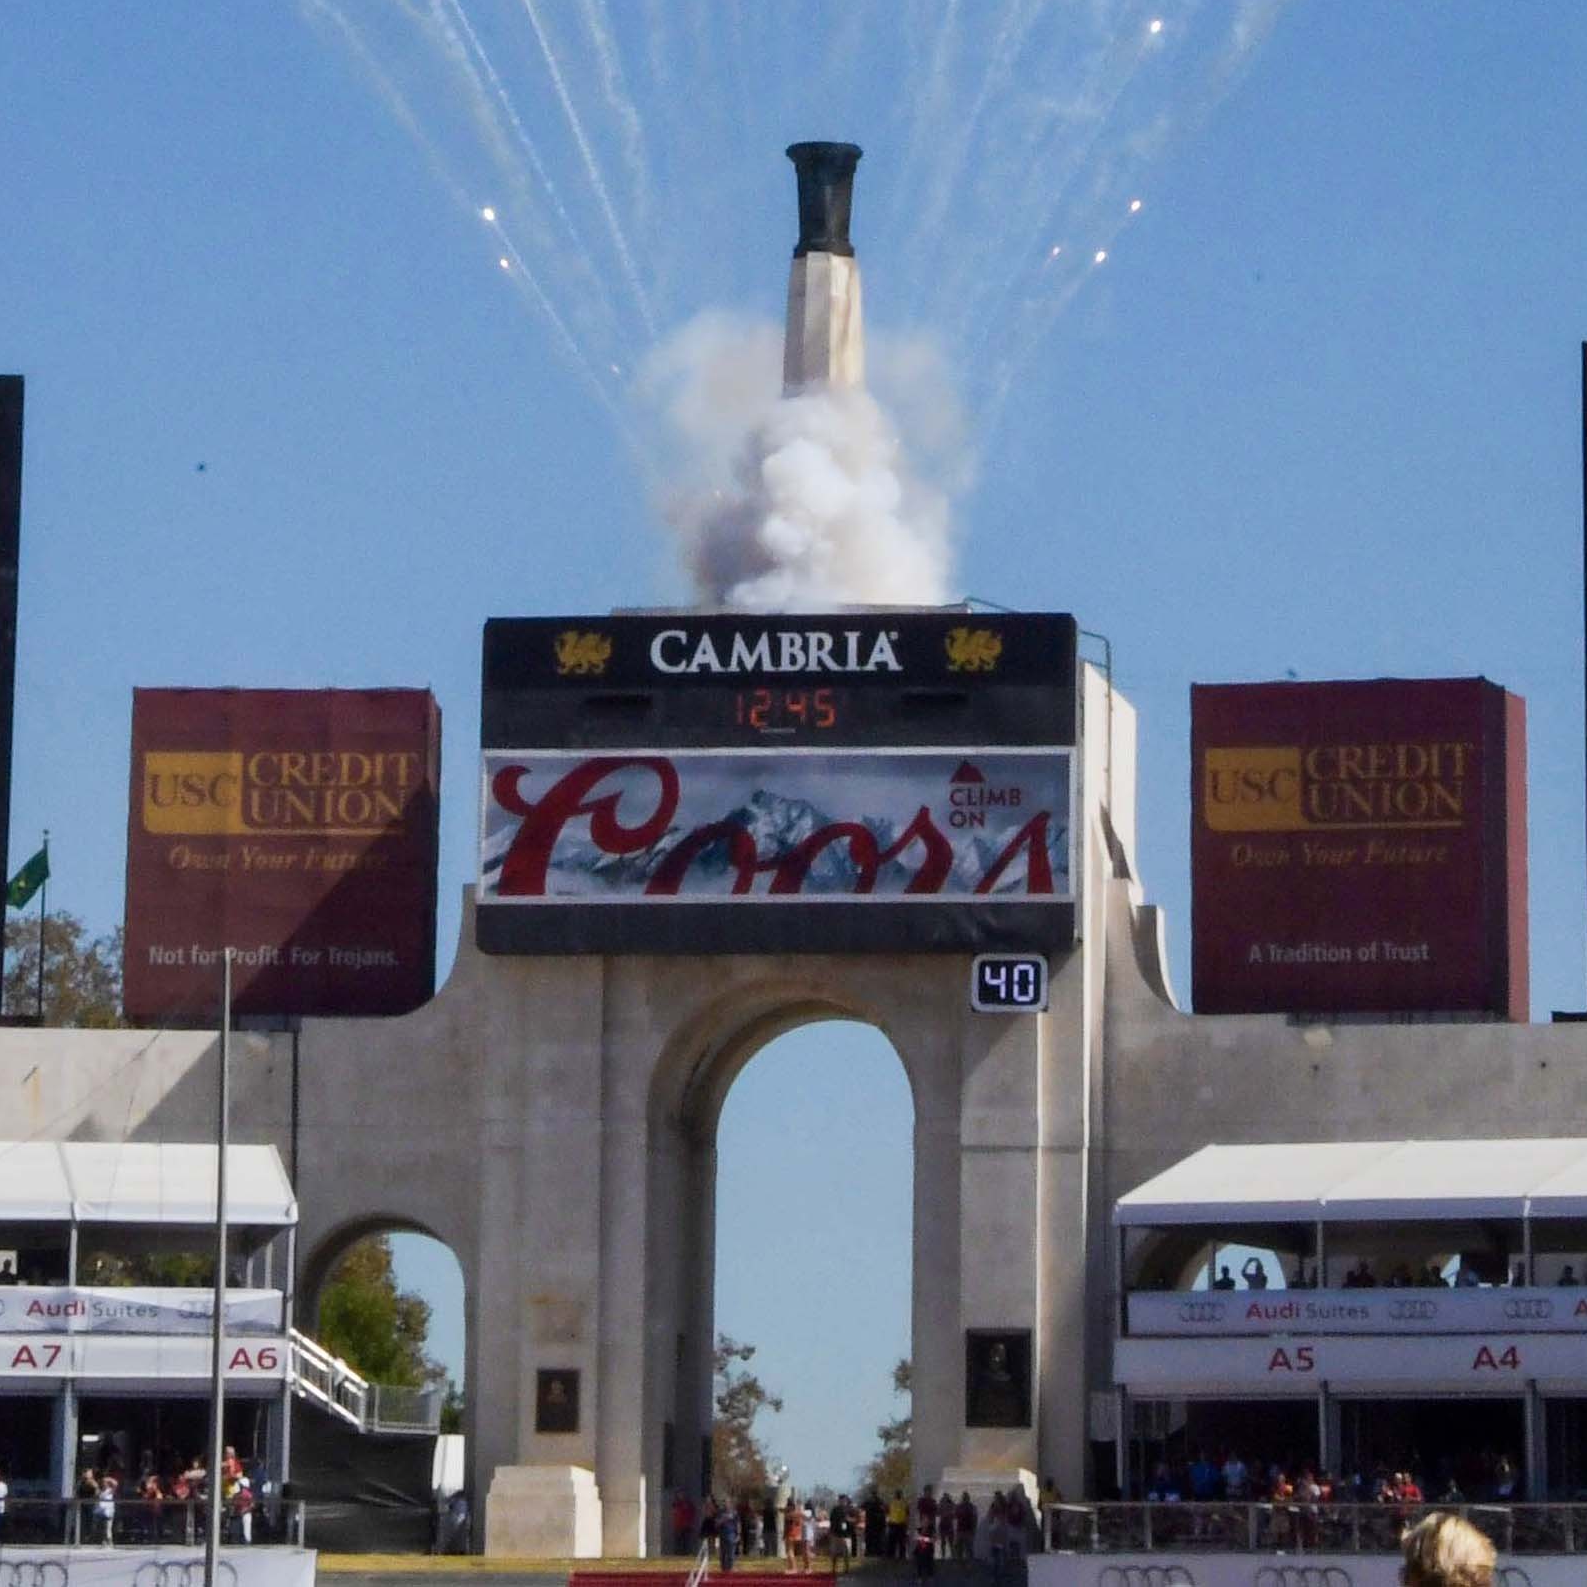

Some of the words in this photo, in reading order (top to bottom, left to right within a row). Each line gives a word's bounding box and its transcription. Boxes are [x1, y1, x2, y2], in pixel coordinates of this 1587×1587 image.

[246, 751, 419, 787] CREDIT
[1306, 743, 1472, 781] CREDIT
[148, 772, 240, 809] USC
[949, 787, 1021, 807] CLIMB
[1210, 768, 1297, 805] USC
[249, 788, 407, 825] UNION
[1308, 780, 1464, 820] UNION
[492, 755, 1055, 895] Coors
[949, 809, 985, 830] ON
[241, 845, 299, 870] Your
[148, 944, 185, 965] Not
[191, 943, 223, 965] for
[291, 946, 326, 965] For
[1248, 944, 1264, 964] A
[1268, 942, 1351, 964] Tradition
[1357, 941, 1377, 963] of
[1381, 941, 1430, 962] Trust
[984, 962, 1034, 1002] 40
[25, 1298, 86, 1318] Audi
[92, 1300, 159, 1319] Suites
[1244, 1299, 1301, 1319] Audi
[1305, 1301, 1371, 1319] Suites
[11, 1344, 63, 1368] A7
[228, 1347, 279, 1370] A6
[1267, 1346, 1315, 1372] A5
[1472, 1344, 1521, 1370] A4
